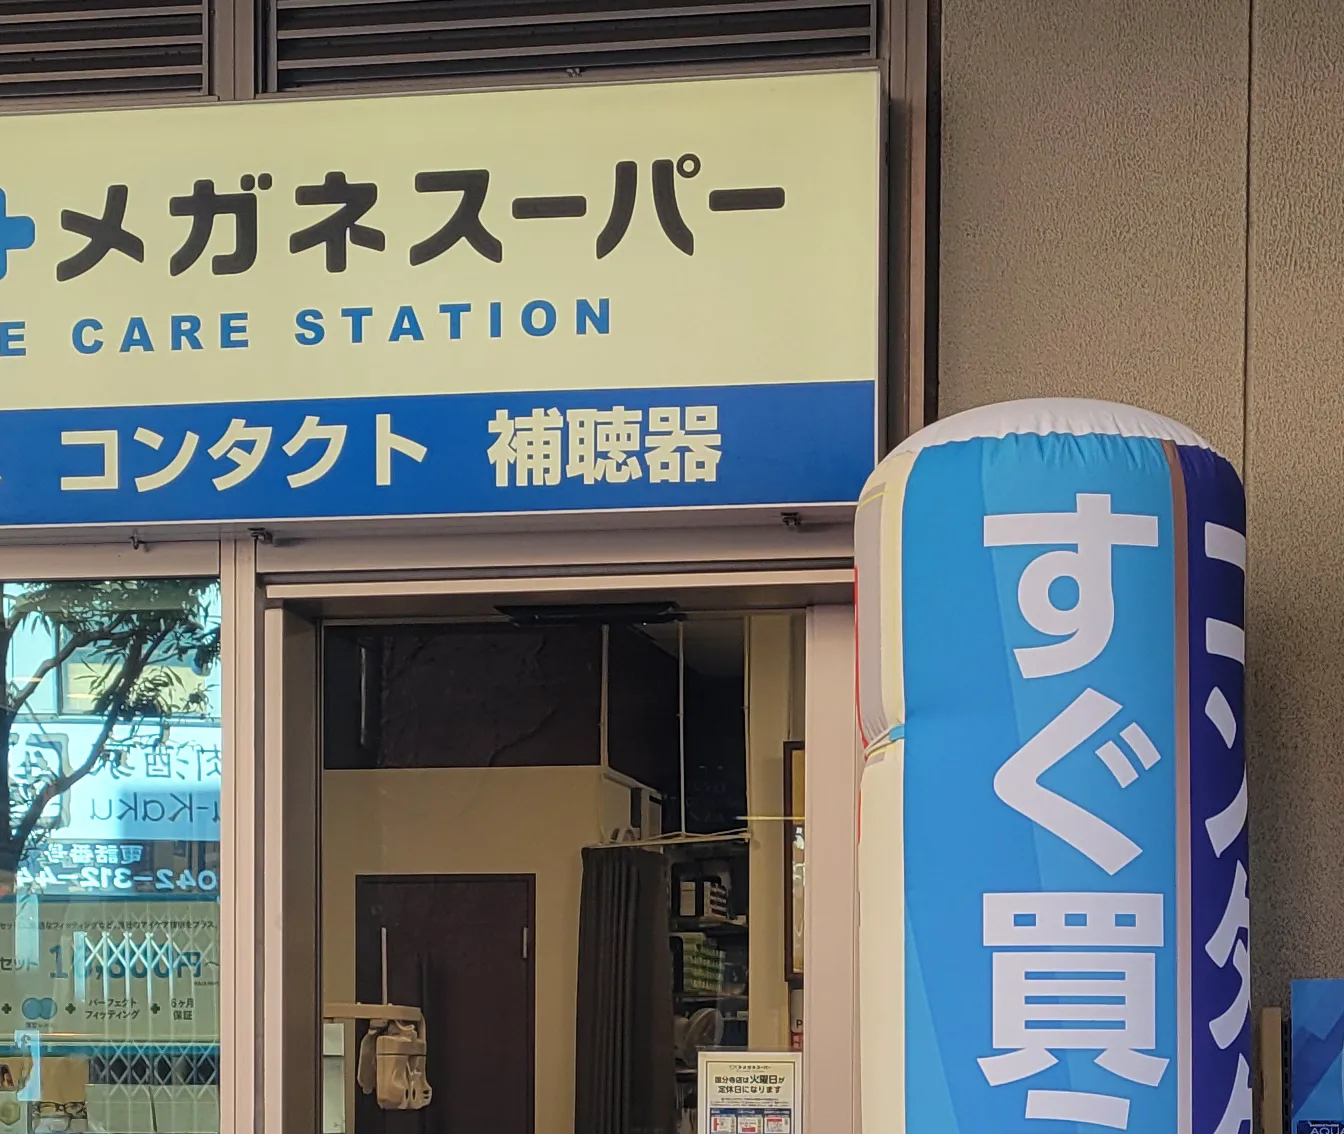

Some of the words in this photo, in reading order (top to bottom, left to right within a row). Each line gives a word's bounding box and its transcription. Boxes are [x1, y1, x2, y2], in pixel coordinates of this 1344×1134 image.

[57, 152, 786, 279] メガネスーパー
[72, 310, 251, 355] CARE
[295, 297, 613, 346] STATION
[60, 413, 427, 493] コンタクト
[488, 404, 722, 487] 補聴器
